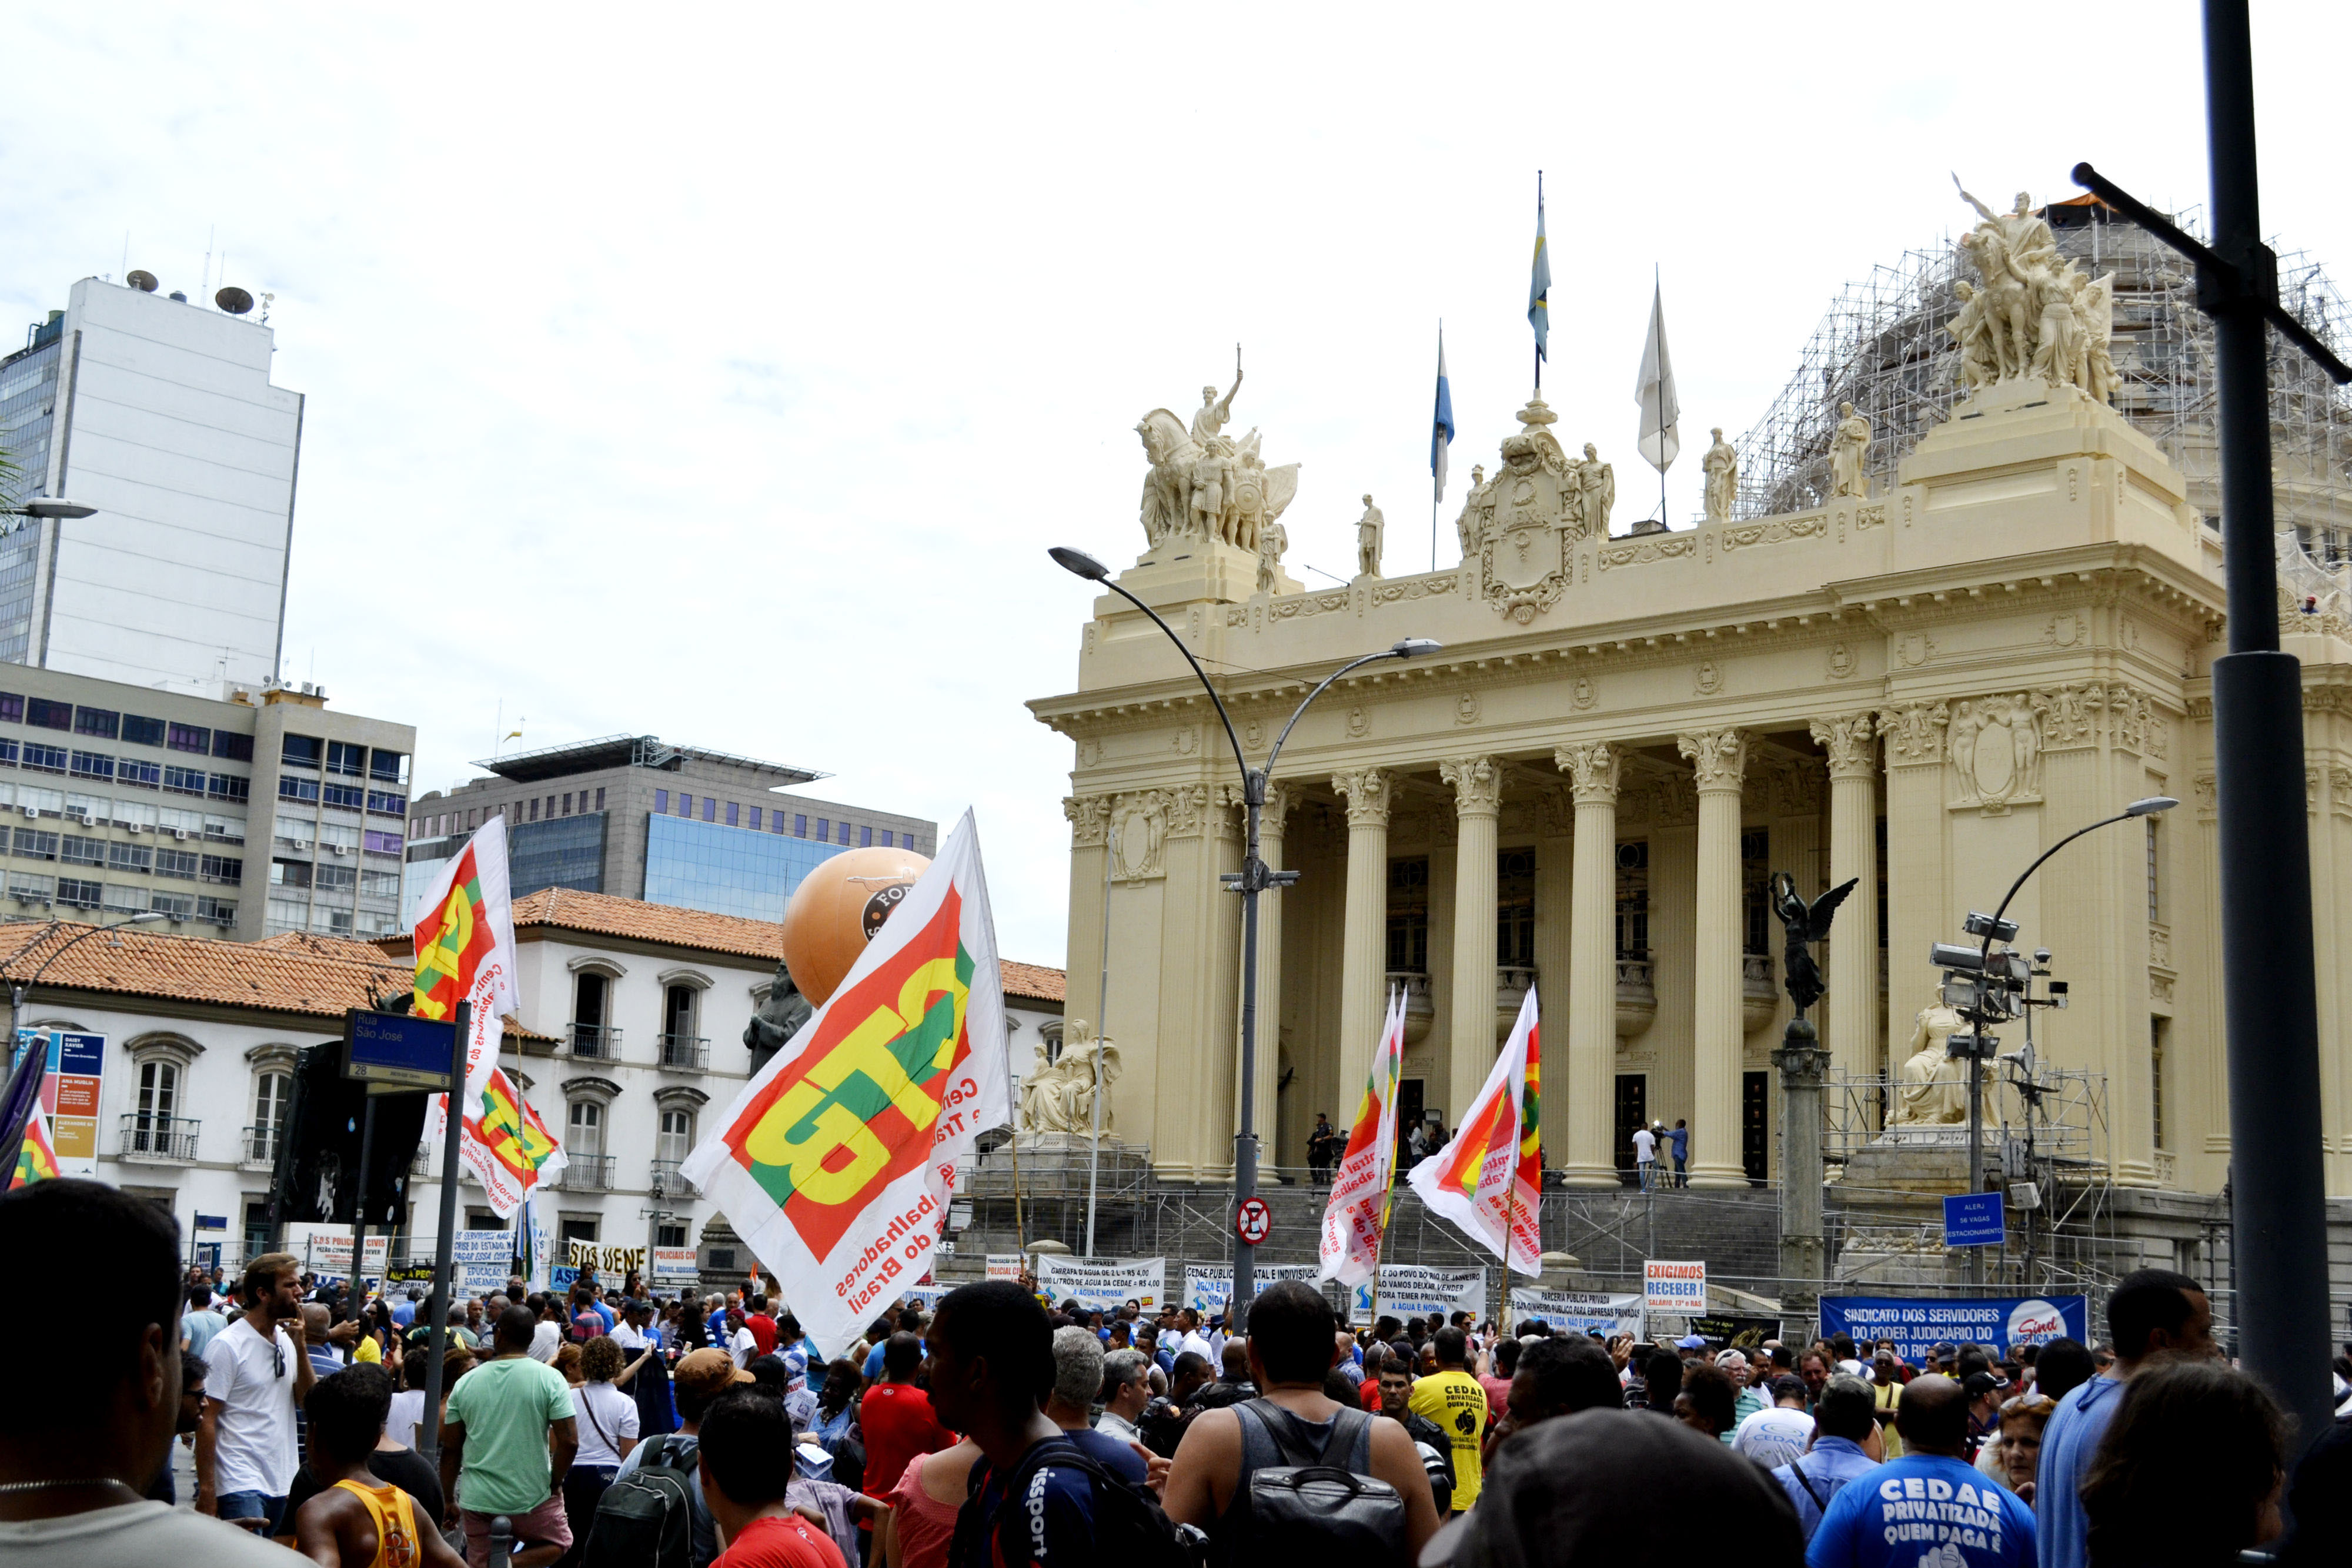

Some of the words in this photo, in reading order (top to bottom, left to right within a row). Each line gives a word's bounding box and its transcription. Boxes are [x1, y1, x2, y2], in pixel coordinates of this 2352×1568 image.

[358, 1014, 377, 1025] Rua
[356, 1027, 376, 1038] São
[379, 1029, 403, 1042] José
[355, 1065, 366, 1075] 28
[441, 1076, 446, 1085] 8
[487, 1188, 510, 1211] Brasil
[1947, 1227, 2002, 1238] ESTACIONAMENTO
[366, 1239, 385, 1247] CIVIS
[471, 1242, 479, 1251] DO
[453, 1252, 473, 1261] PAGAR
[475, 1252, 492, 1261] ESSA
[603, 1247, 646, 1275] UENF
[655, 1250, 684, 1260] POLICIAIS
[686, 1251, 697, 1260] CIV
[467, 1266, 502, 1277] EDUCAÇÃO
[987, 1266, 1011, 1275] POLICIAL
[1051, 1268, 1077, 1276] GARRAFA
[1137, 1269, 1150, 1278] 4,00
[1187, 1267, 1208, 1279] CEDAE
[1209, 1266, 1234, 1279] PÚBLIC
[1272, 1269, 1276, 1280] E
[1399, 1271, 1417, 1279] POVO
[1451, 1273, 1481, 1282] JANEIRO
[1647, 1264, 1703, 1279] EXIGIMOS
[1148, 1279, 1161, 1288] 4,00
[1388, 1281, 1411, 1289] VAMOS
[1413, 1282, 1435, 1290] DEIXAR
[1436, 1283, 1464, 1292] VENDER
[1648, 1281, 1697, 1296] RECEBER
[1207, 1295, 1224, 1306] DIGA
[1378, 1291, 1395, 1299] FORA
[1398, 1292, 1418, 1300] TEMER
[1421, 1293, 1459, 1303] PRIVATISTA!
[1541, 1292, 1565, 1302] PARCERIA
[1589, 1295, 1610, 1305] PRIVADA
[1423, 1303, 1446, 1313] NOSSA!
[1573, 1305, 1586, 1316] PARA
[1588, 1306, 1614, 1318] EMPRESAS
[1615, 1308, 1640, 1319] PRIVADAS
[1844, 1308, 1899, 1322] SINDICATO
[1902, 1308, 1926, 1322] DOS
[1929, 1308, 1999, 1322] SERVIDORES
[1852, 1326, 1867, 1339] DO
[1870, 1326, 1908, 1340] PODER
[1911, 1323, 1973, 1340] JUDICIÁRIO
[1976, 1326, 1993, 1340] DO
[2019, 1316, 2057, 1344] Sind
[1445, 1385, 1482, 1398] CEDAE
[1446, 1395, 1483, 1404] PRIVATIZADA
[1754, 1434, 1805, 1449] CEDAE
[1880, 1477, 2000, 1514] CEDAE
[1025, 1466, 1056, 1557] issport
[1882, 1501, 2000, 1534] PRIVATIZADA
[1884, 1524, 1935, 1545] QUEM
[1938, 1525, 1988, 1550] PAGA
